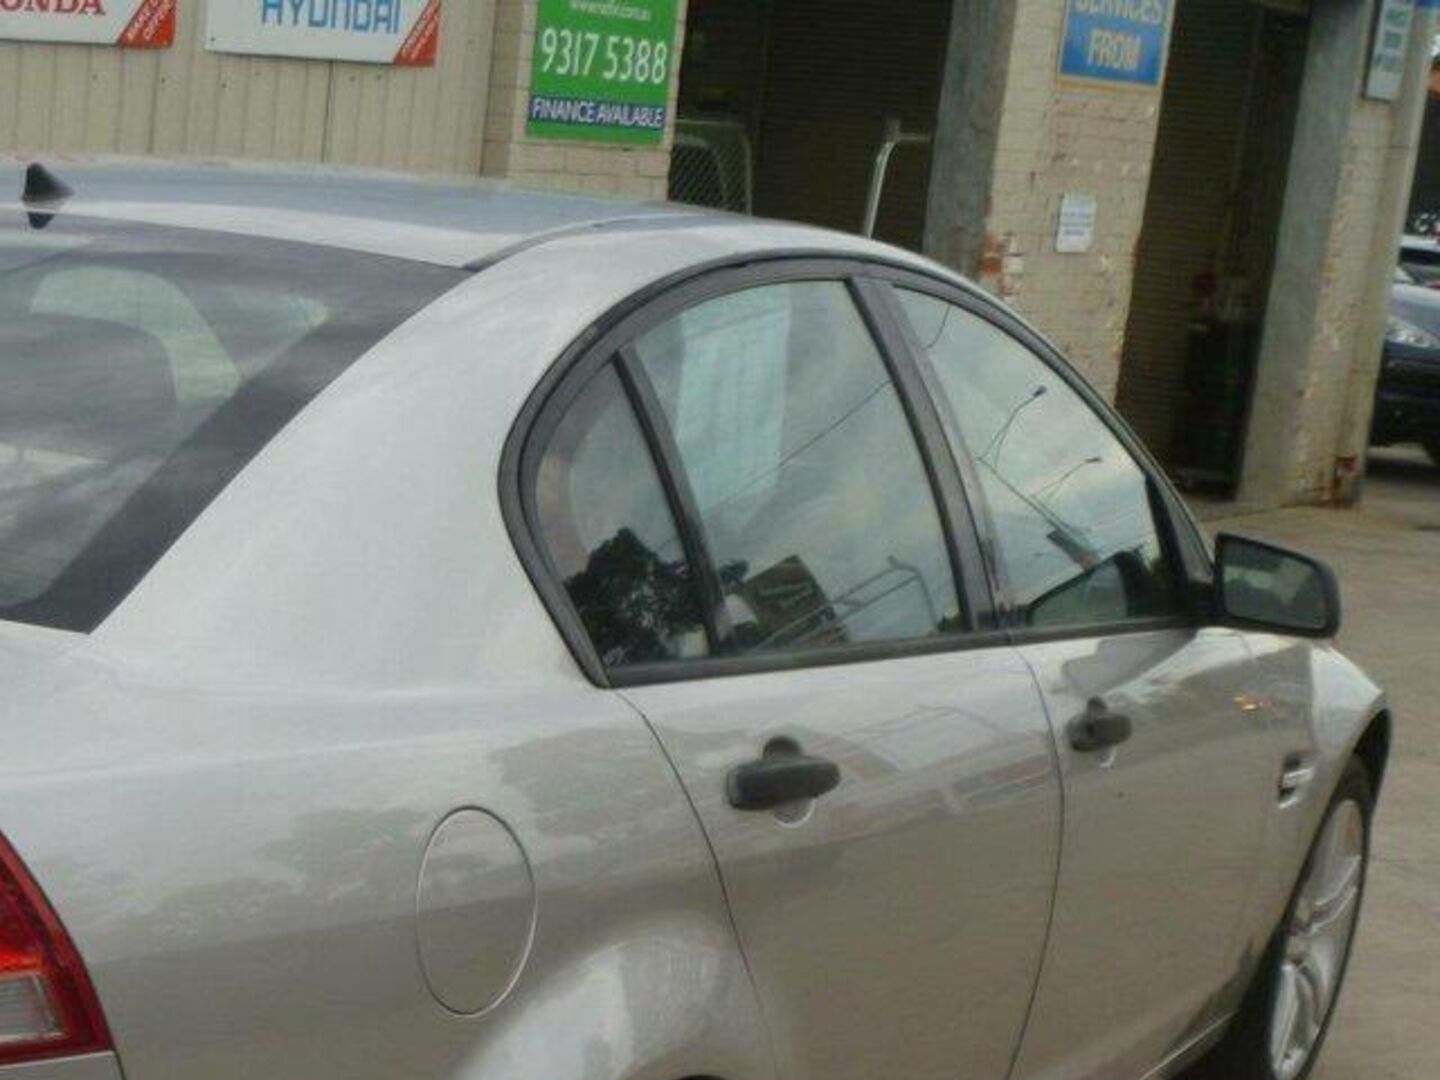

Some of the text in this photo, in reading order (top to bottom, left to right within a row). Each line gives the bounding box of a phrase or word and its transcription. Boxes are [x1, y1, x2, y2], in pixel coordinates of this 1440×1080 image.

[261, 0, 401, 34] HYUNDAI
[541, 27, 668, 85] 9317 5388
[531, 97, 664, 128] FINANCE AVAILABLE
